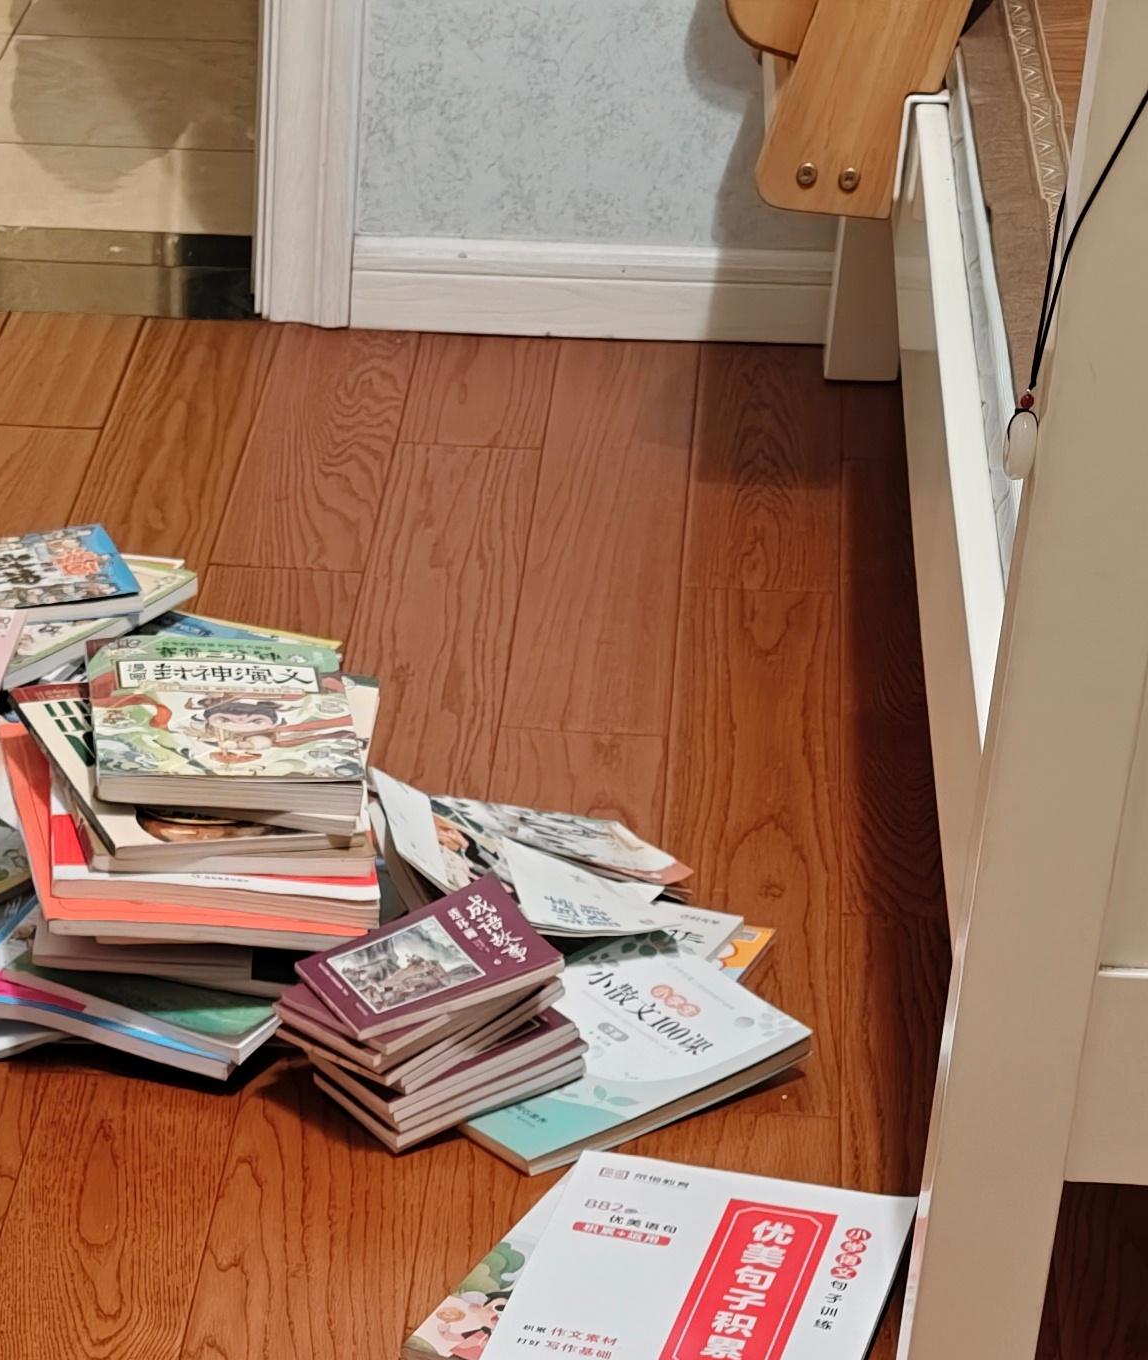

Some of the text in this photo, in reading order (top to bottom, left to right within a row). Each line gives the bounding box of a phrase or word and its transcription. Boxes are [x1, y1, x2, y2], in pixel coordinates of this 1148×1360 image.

[153, 663, 315, 685] 封神演义
[465, 894, 528, 964] 成语故事
[587, 970, 714, 1057] 小散文100课
